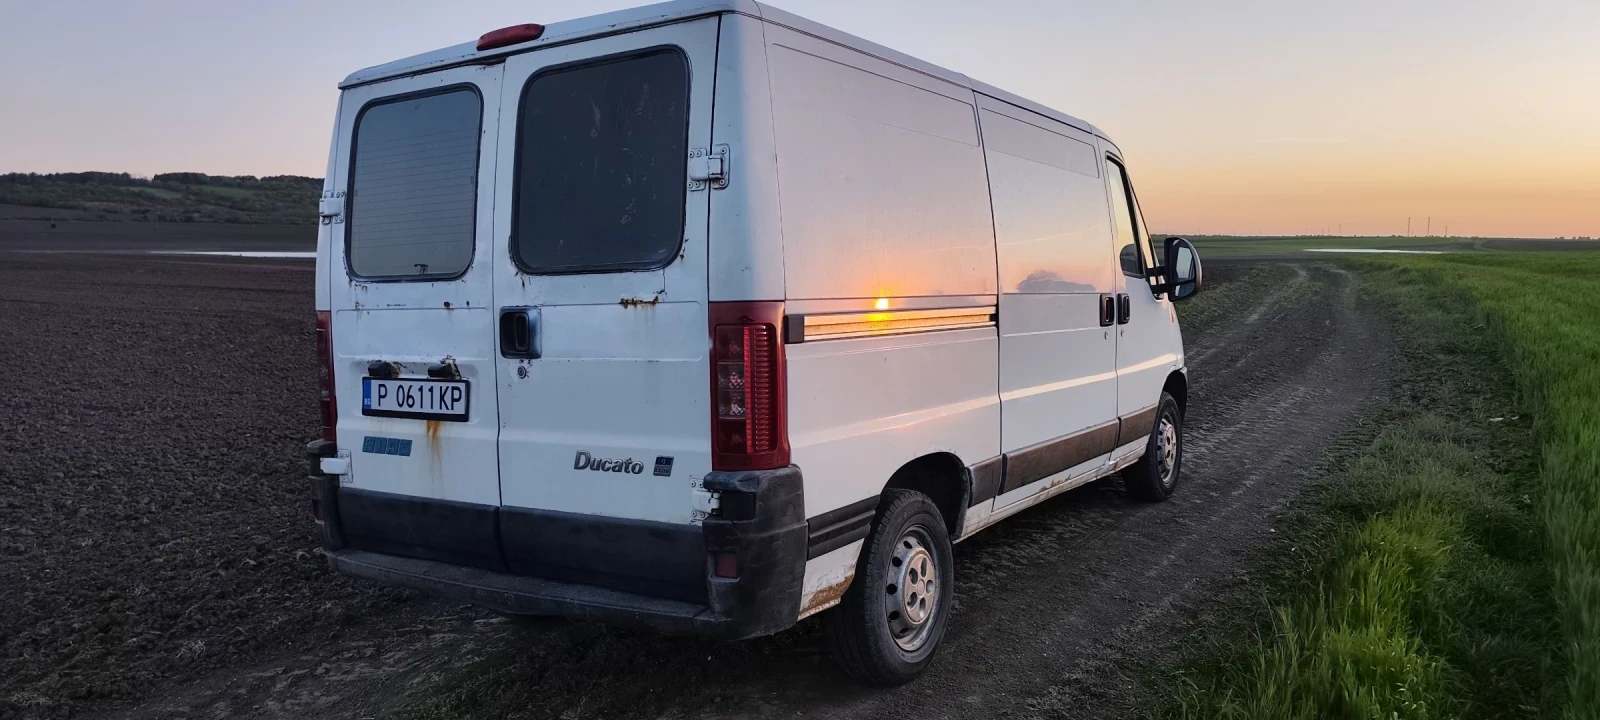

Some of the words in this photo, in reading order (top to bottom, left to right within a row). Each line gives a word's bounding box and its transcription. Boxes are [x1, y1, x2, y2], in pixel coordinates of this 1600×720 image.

[378, 383, 388, 407] P
[363, 436, 412, 456] FIAT
[574, 450, 644, 475] Ducato
